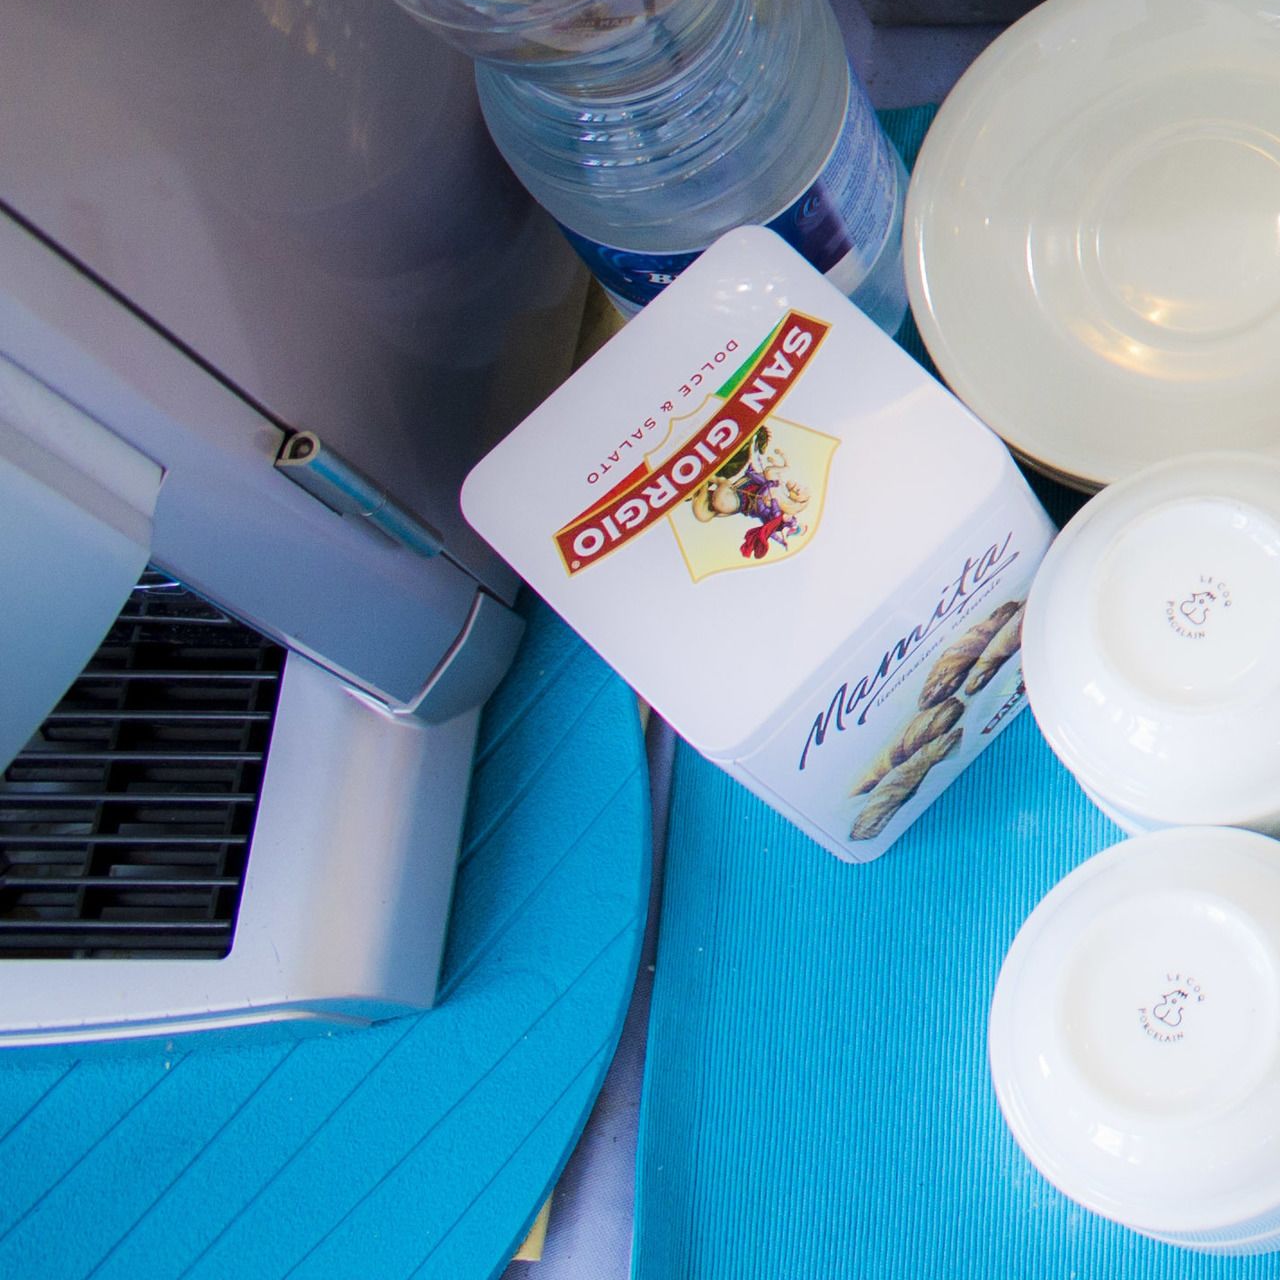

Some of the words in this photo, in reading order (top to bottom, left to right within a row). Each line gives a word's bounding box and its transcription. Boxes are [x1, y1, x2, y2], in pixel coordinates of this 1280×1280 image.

[660, 400, 674, 413] &
[677, 338, 740, 399] DOLCE
[732, 324, 815, 415] SAN
[570, 418, 743, 559] GIORGIO
[586, 416, 657, 485] SALATO
[799, 531, 1019, 771] Mamita
